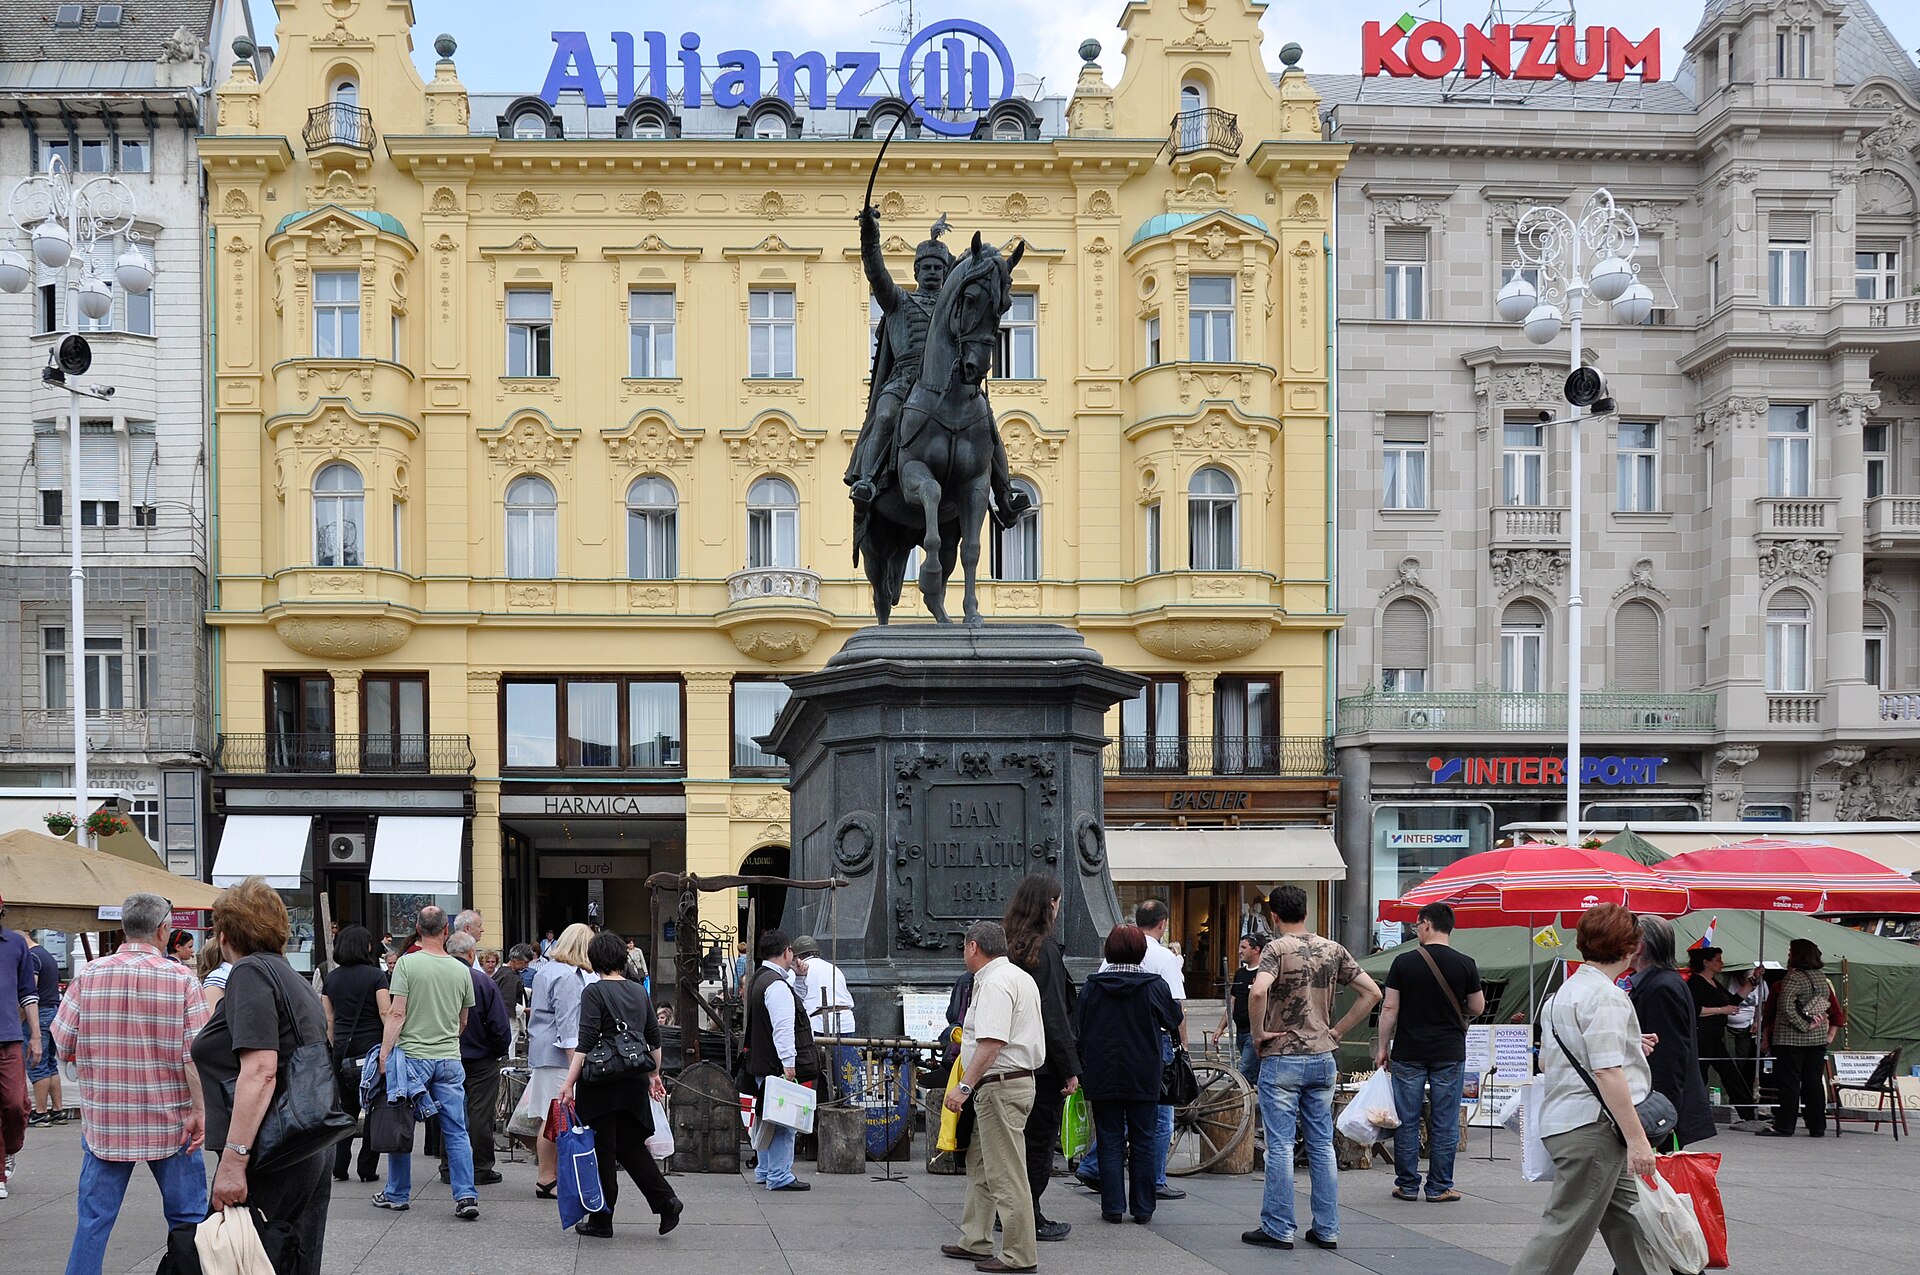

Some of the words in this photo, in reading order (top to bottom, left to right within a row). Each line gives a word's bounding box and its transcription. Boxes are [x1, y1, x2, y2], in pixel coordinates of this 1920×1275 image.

[1361, 14, 1661, 83] KONZUM
[540, 30, 881, 109] Allianz
[87, 769, 139, 780] METRO
[87, 780, 155, 791] OLDING“
[544, 797, 641, 815] HARMICA
[1169, 791, 1249, 809] BASLER
[950, 801, 1003, 828] BAN
[1404, 834, 1463, 844] INTERSPORT
[928, 834, 1024, 868] JELAČIĆ
[574, 861, 613, 875] Laurèl
